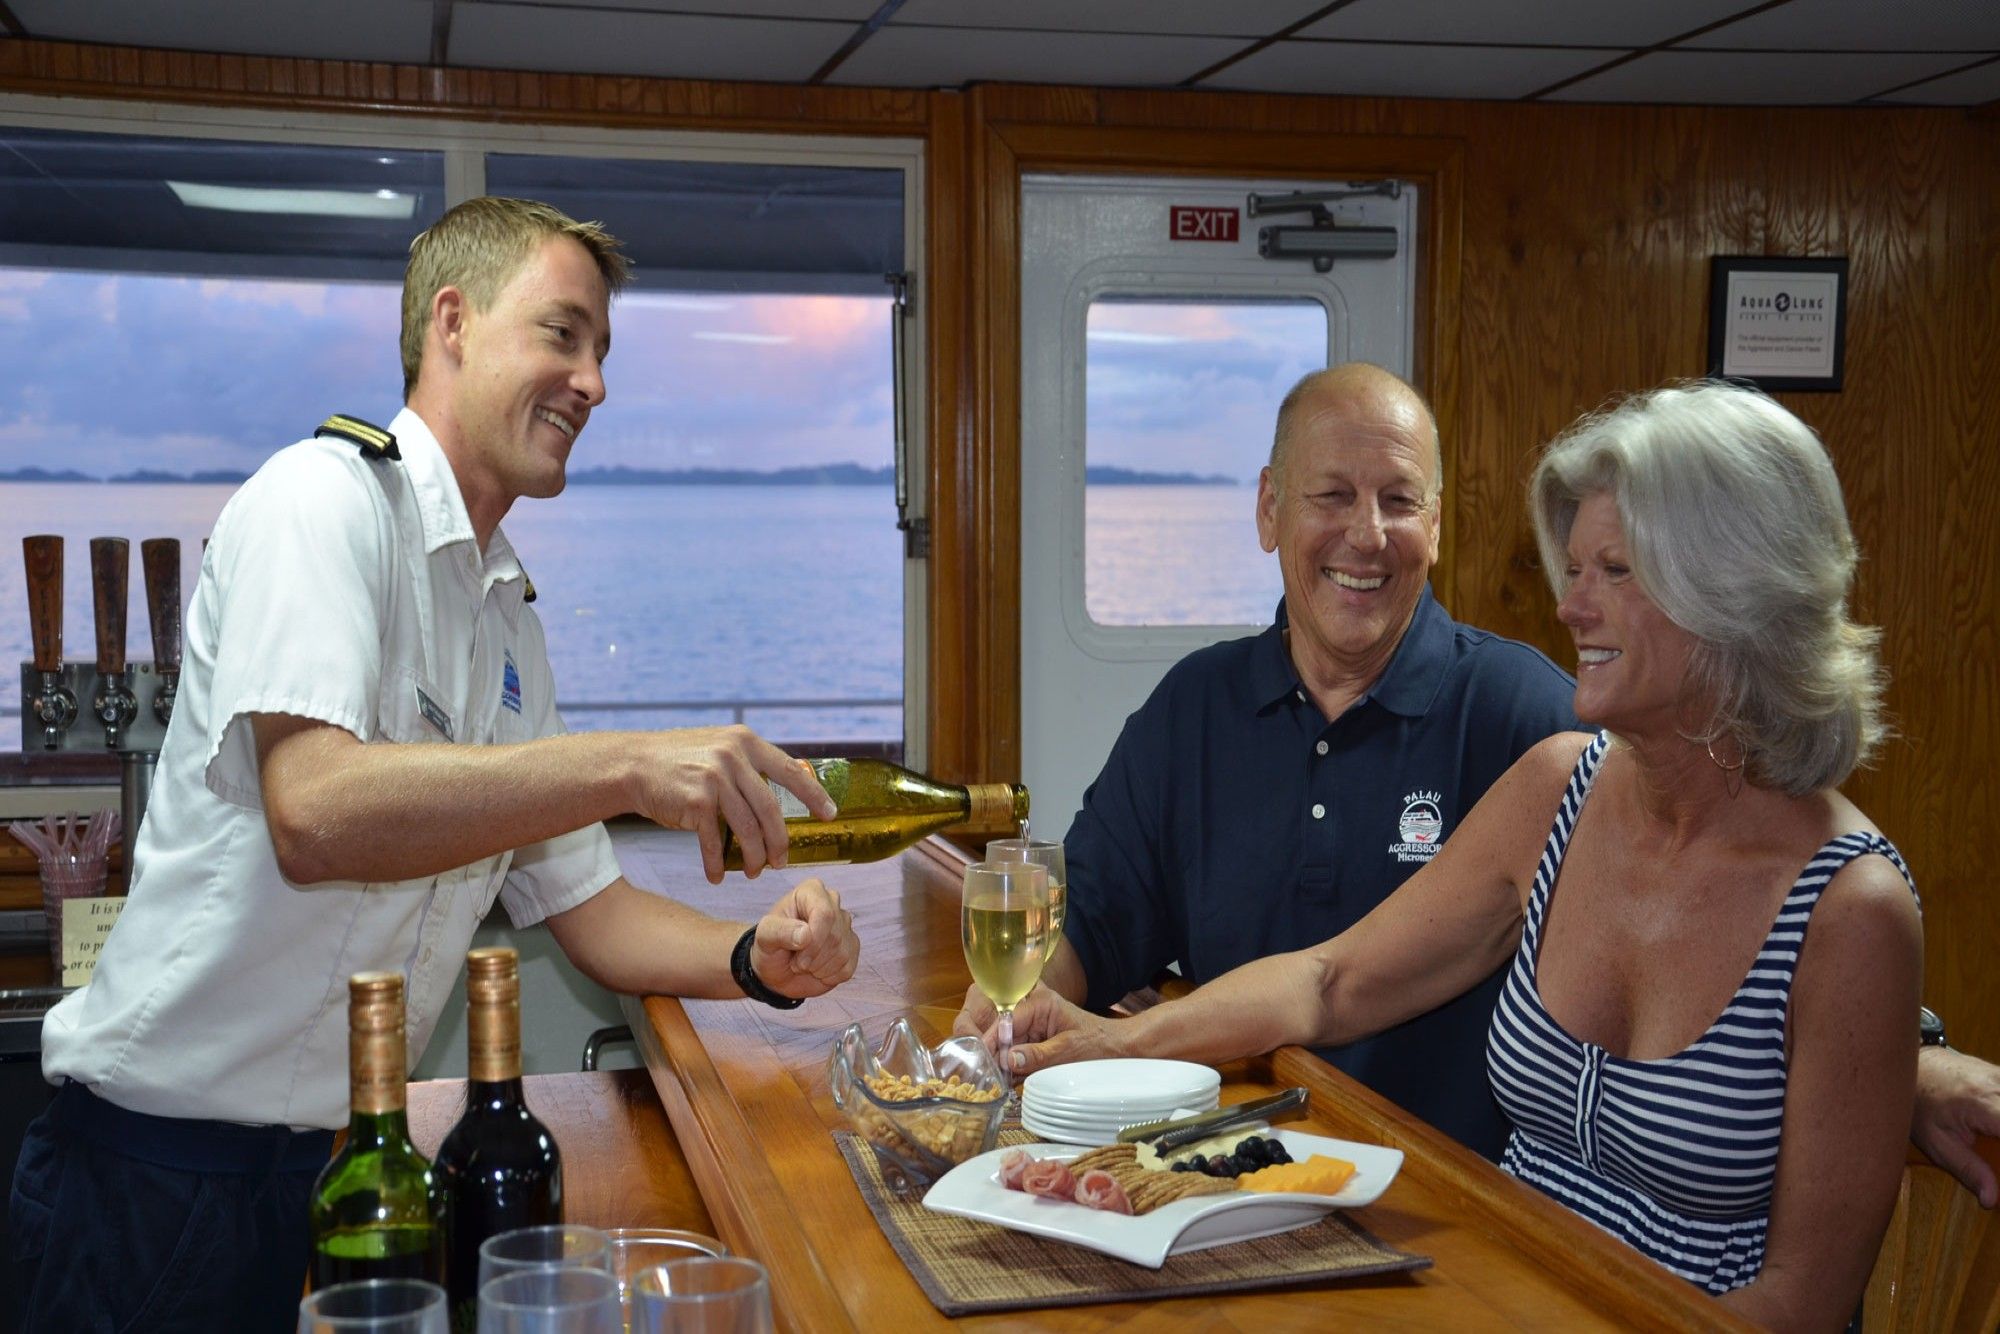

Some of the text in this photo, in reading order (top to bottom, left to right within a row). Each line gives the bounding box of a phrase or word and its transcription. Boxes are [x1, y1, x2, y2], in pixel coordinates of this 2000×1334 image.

[1177, 210, 1234, 238] EXIT
[1740, 296, 1824, 310] AQUA LUNG
[1403, 790, 1441, 804] PALAU
[90, 903, 100, 915] It
[104, 902, 112, 914] is
[79, 942, 90, 951] to
[70, 961, 82, 970] or
